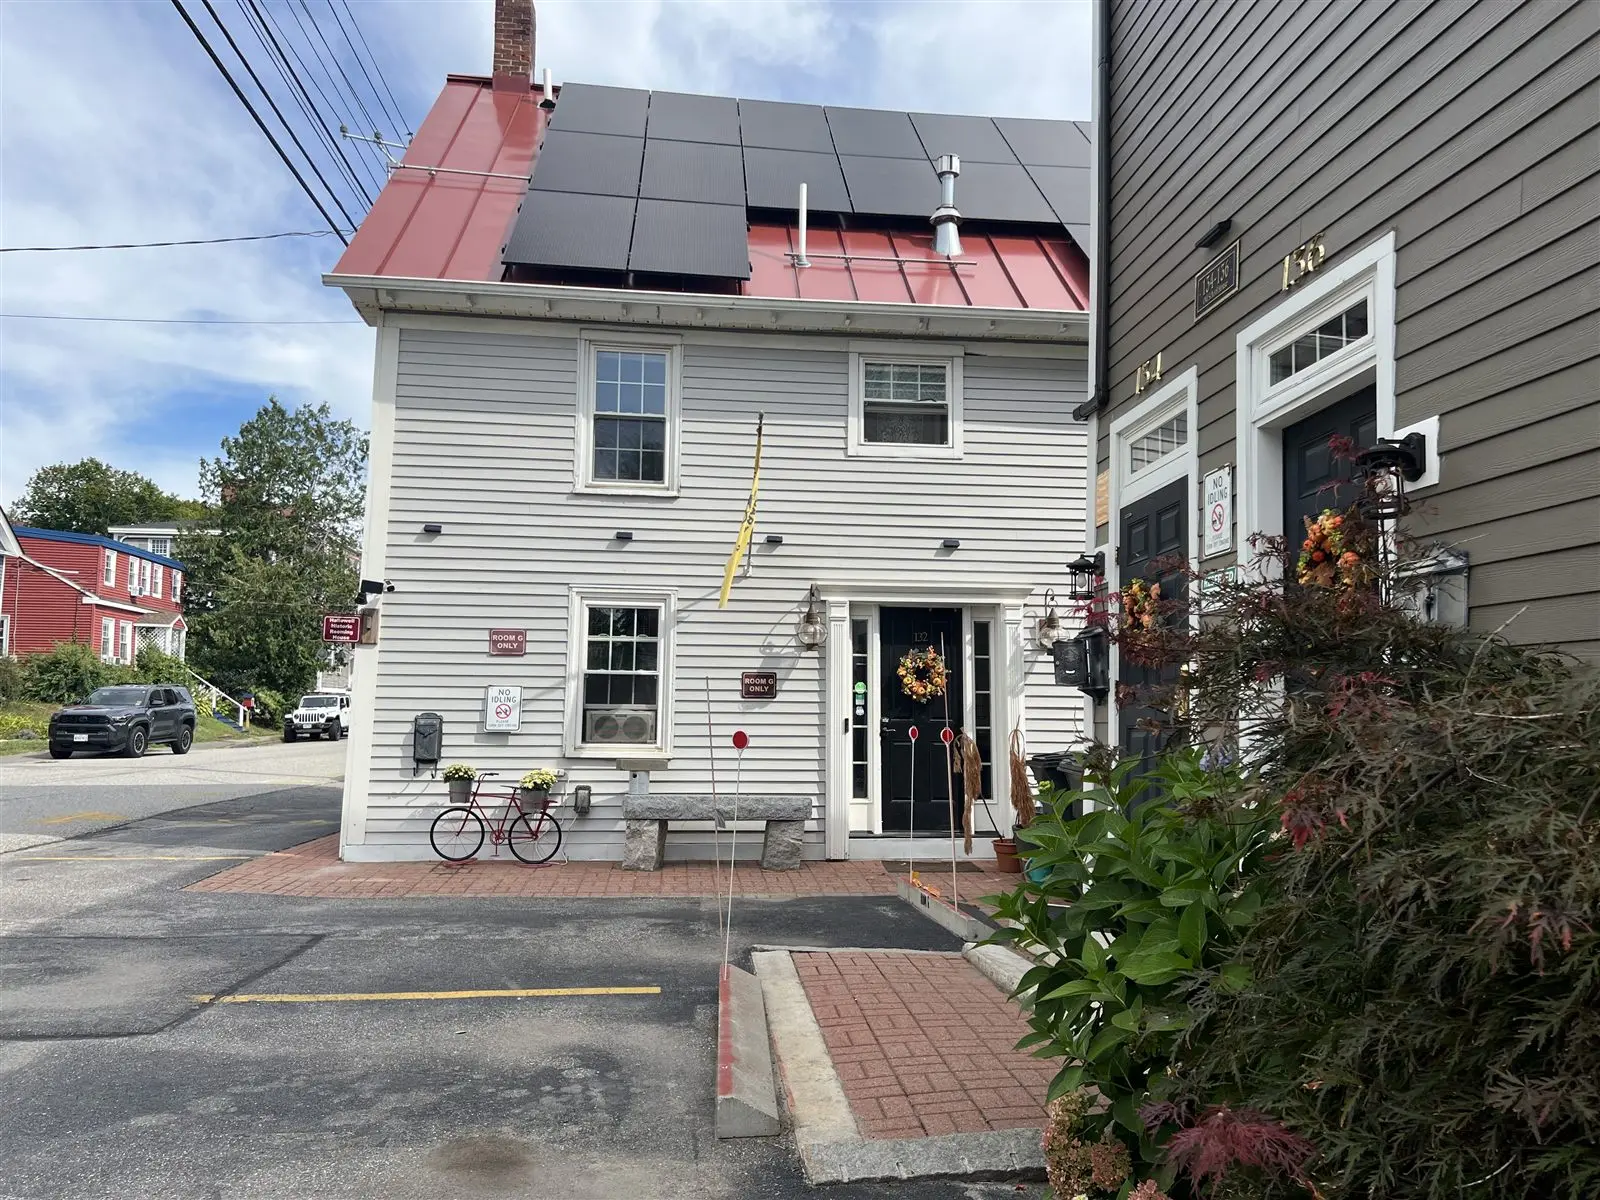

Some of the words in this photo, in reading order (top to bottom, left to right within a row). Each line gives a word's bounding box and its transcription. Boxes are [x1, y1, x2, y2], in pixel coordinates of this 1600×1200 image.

[1282, 232, 1326, 291] 156
[1135, 351, 1162, 394] 154
[1213, 475, 1223, 490] NO
[1207, 486, 1228, 506] IDLING
[491, 696, 517, 704] IDLING
